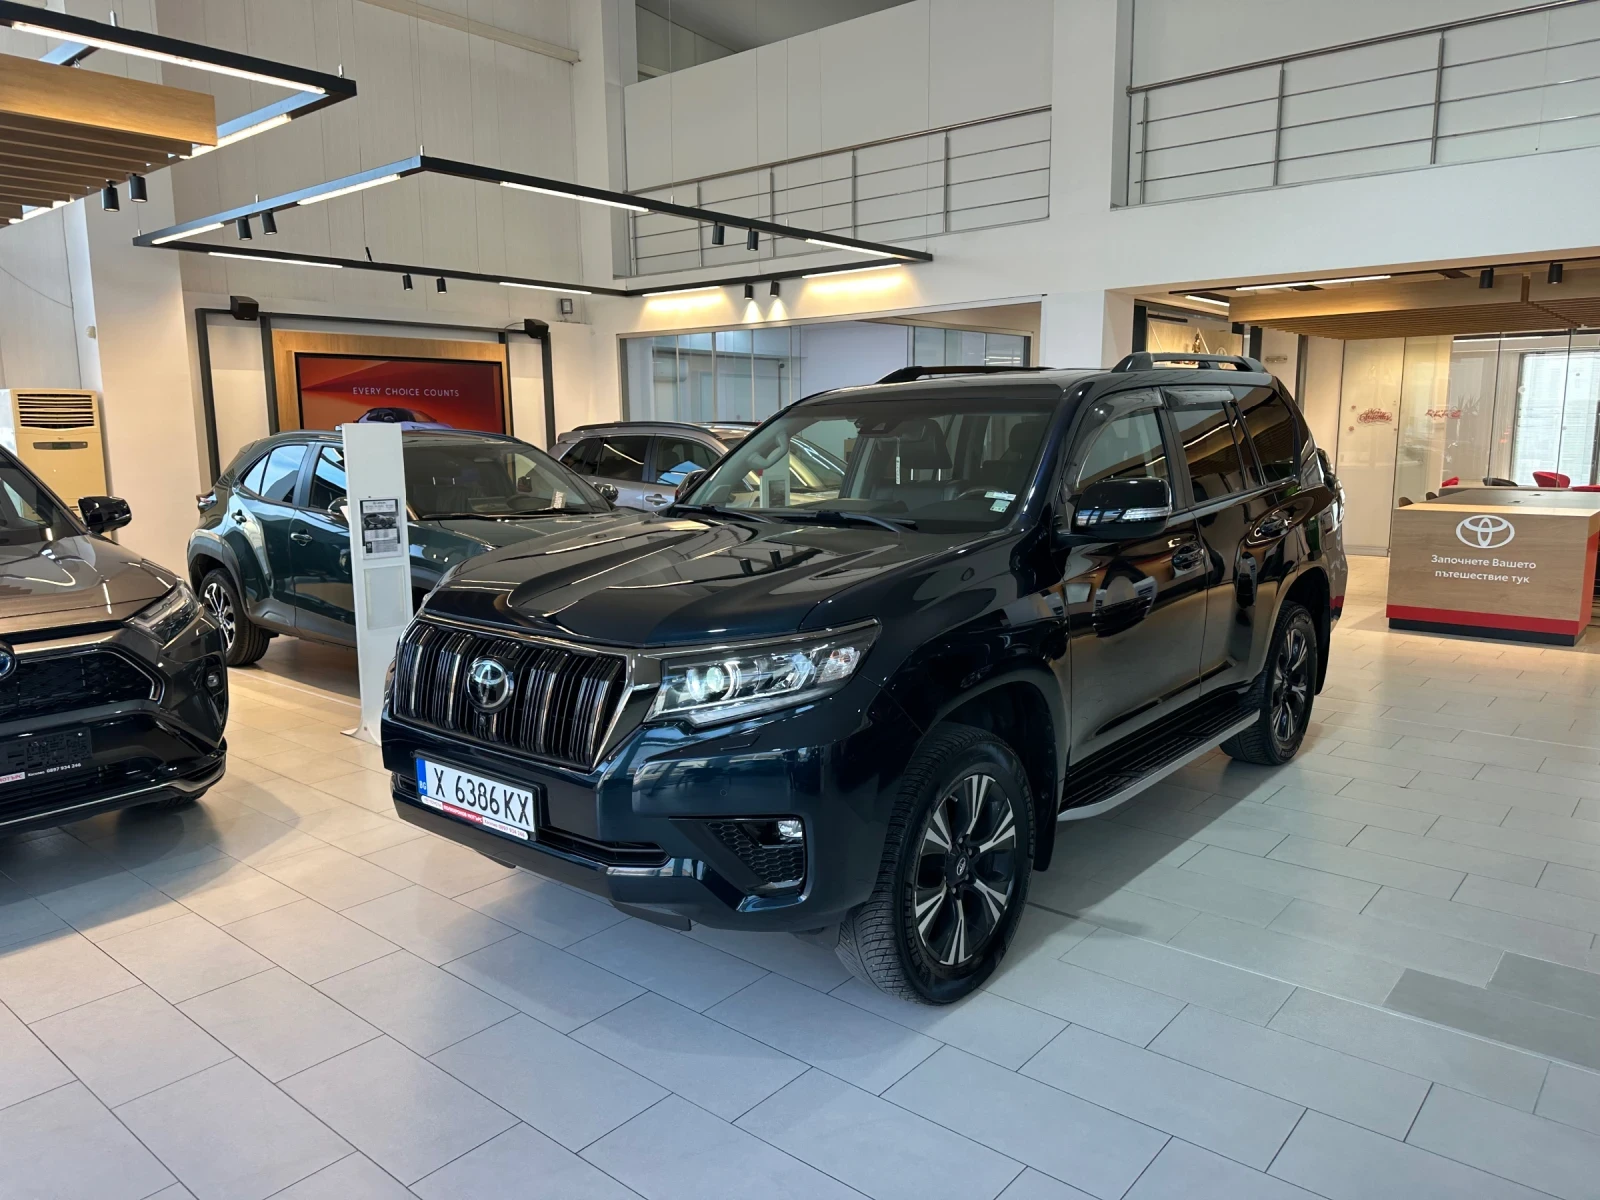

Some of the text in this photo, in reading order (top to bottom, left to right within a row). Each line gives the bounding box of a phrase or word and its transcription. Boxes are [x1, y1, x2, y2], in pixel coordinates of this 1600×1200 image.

[353, 387, 460, 397] EVERY CHOICE COUNTS
[1431, 554, 1537, 570] Започнете Вашето
[1435, 570, 1530, 585] пътешествие тук
[419, 780, 427, 790] BG
[434, 767, 445, 798] X
[1021, 785, 1034, 857] MICHELIN
[904, 886, 922, 968] MICHELIN
